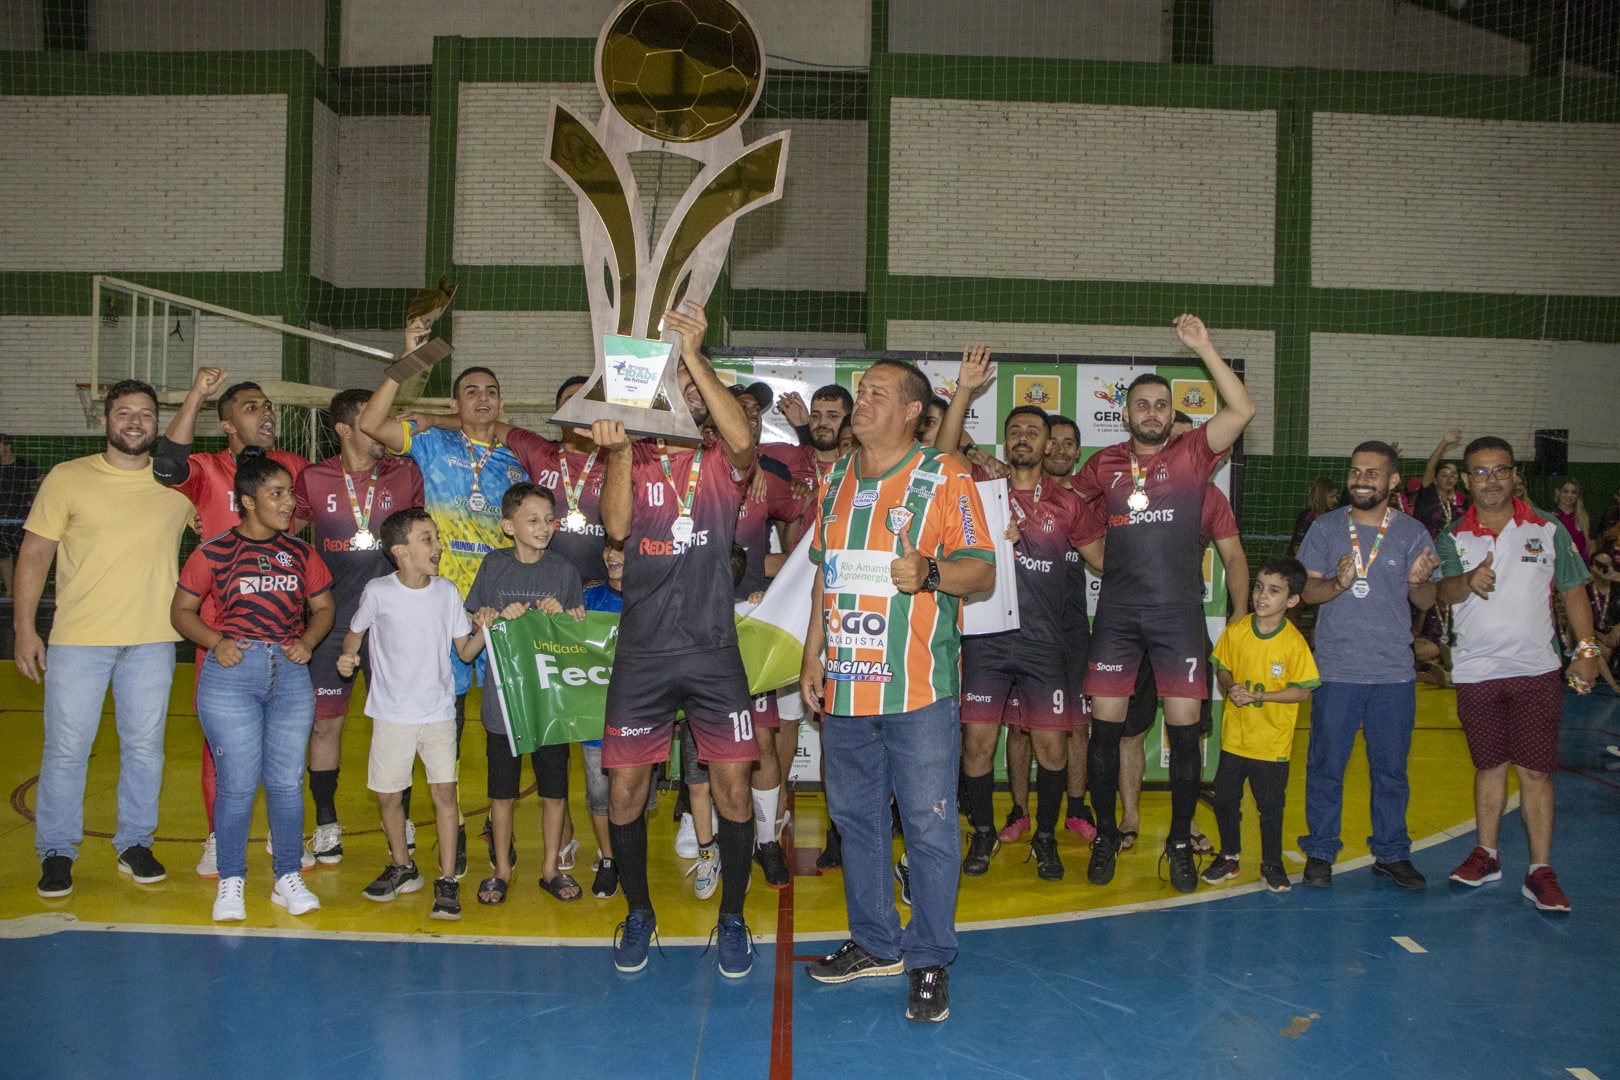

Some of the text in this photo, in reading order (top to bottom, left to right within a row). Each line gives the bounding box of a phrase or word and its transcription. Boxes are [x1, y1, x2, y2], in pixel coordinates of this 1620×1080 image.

[619, 368, 658, 381] CIDADE
[1094, 411, 1125, 422] GER
[538, 469, 560, 490] 20
[1110, 471, 1122, 489] 7
[227, 490, 239, 512] 1
[327, 493, 337, 513] 5
[646, 481, 664, 507] 10
[451, 539, 475, 552] MUNDO
[840, 562, 891, 573] Rio Amamb
[261, 574, 298, 592] BRB
[838, 571, 888, 583] Agroenergia
[533, 640, 588, 654] Unidade
[535, 653, 613, 690] Fec
[827, 659, 893, 676] ORIGINAL
[1185, 657, 1198, 683] 7
[1052, 689, 1064, 714] 9
[728, 710, 753, 743] 10
